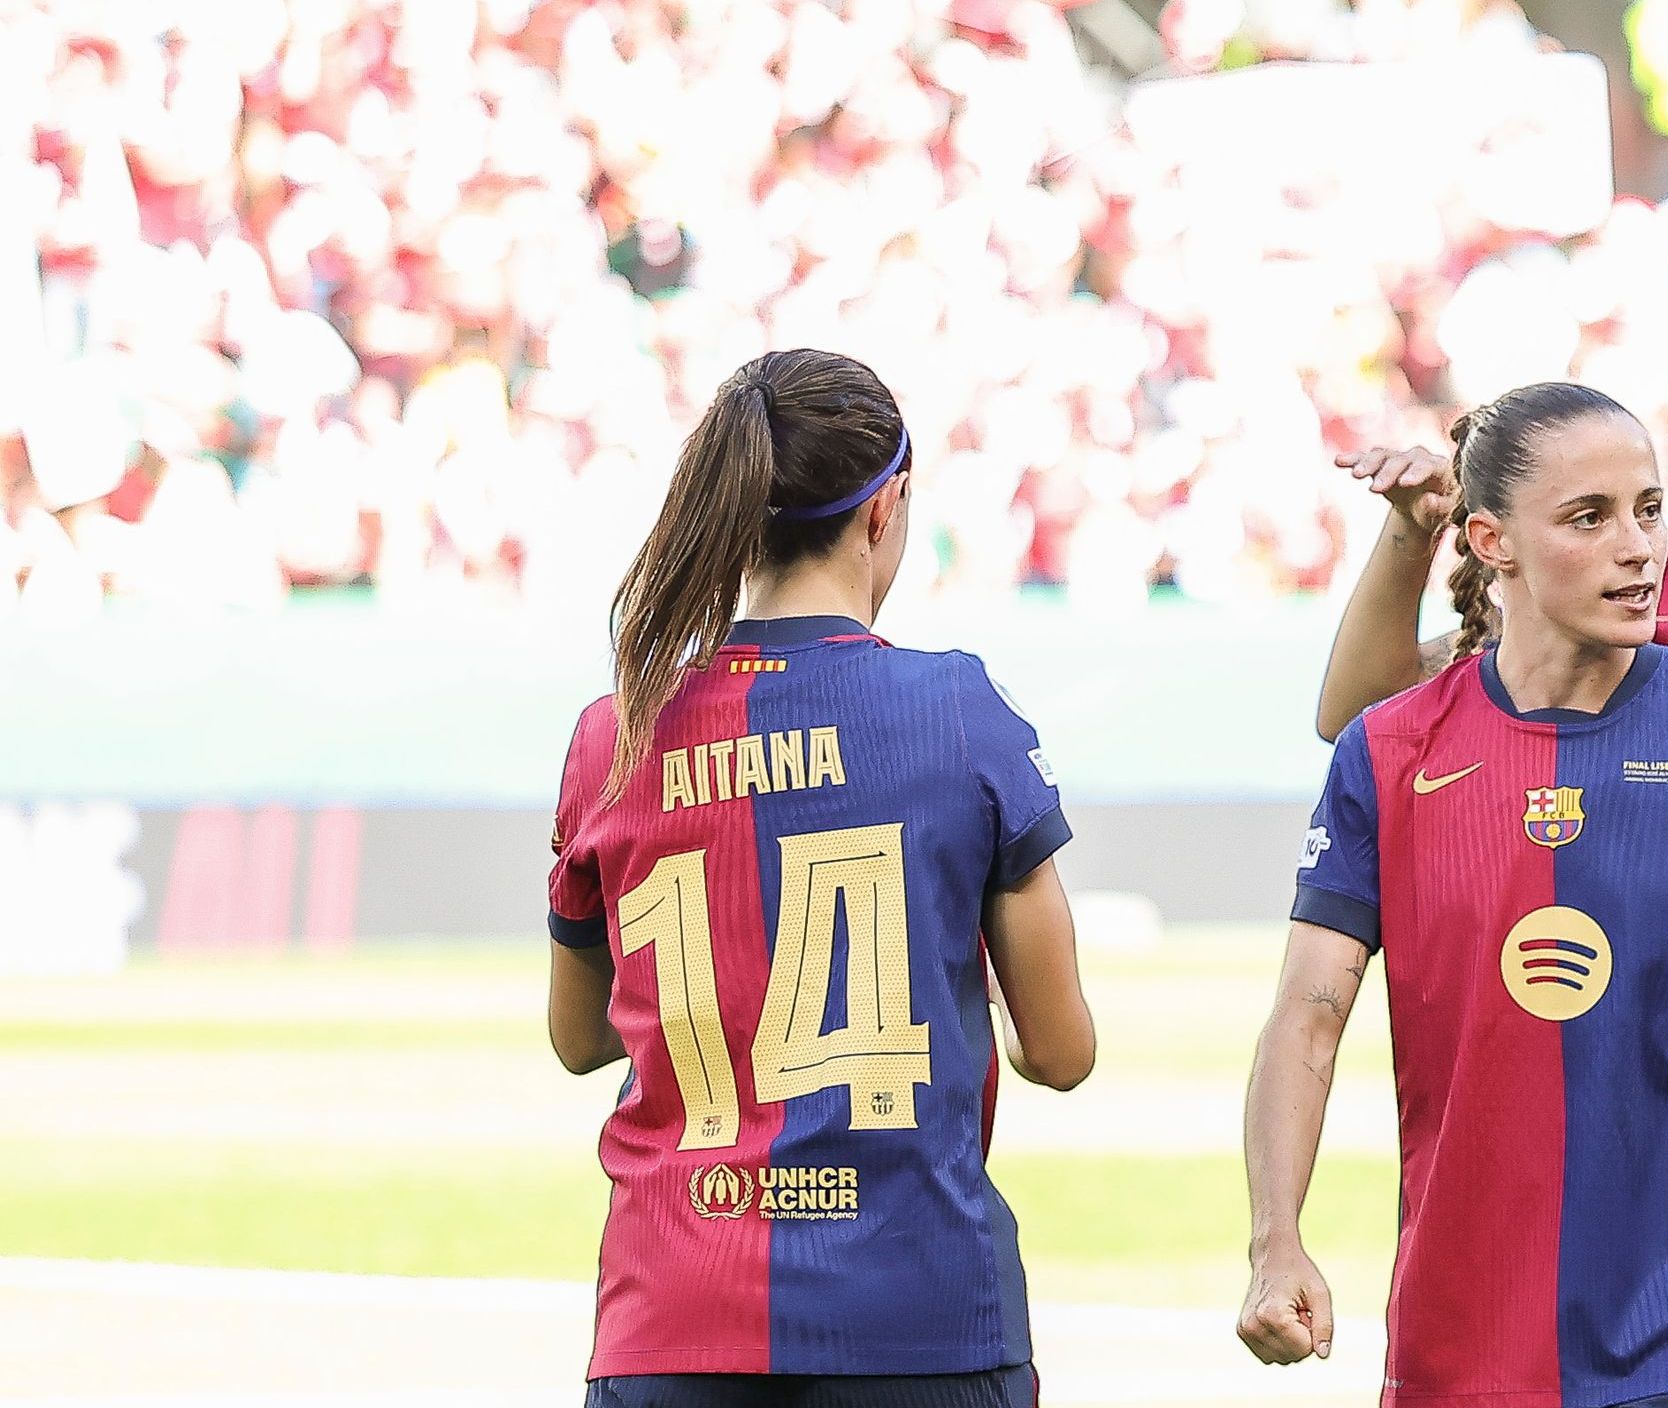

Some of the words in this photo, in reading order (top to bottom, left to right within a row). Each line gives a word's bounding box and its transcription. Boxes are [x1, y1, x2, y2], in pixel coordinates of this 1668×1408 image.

[662, 726, 846, 812] AITANA
[617, 822, 932, 1151] 14
[758, 1166, 859, 1189] UNHCR
[758, 1189, 859, 1210] ACNUR
[760, 1211, 775, 1219] The
[776, 1211, 789, 1219] UN
[790, 1211, 825, 1221] Refugee
[826, 1211, 859, 1221] Agency
